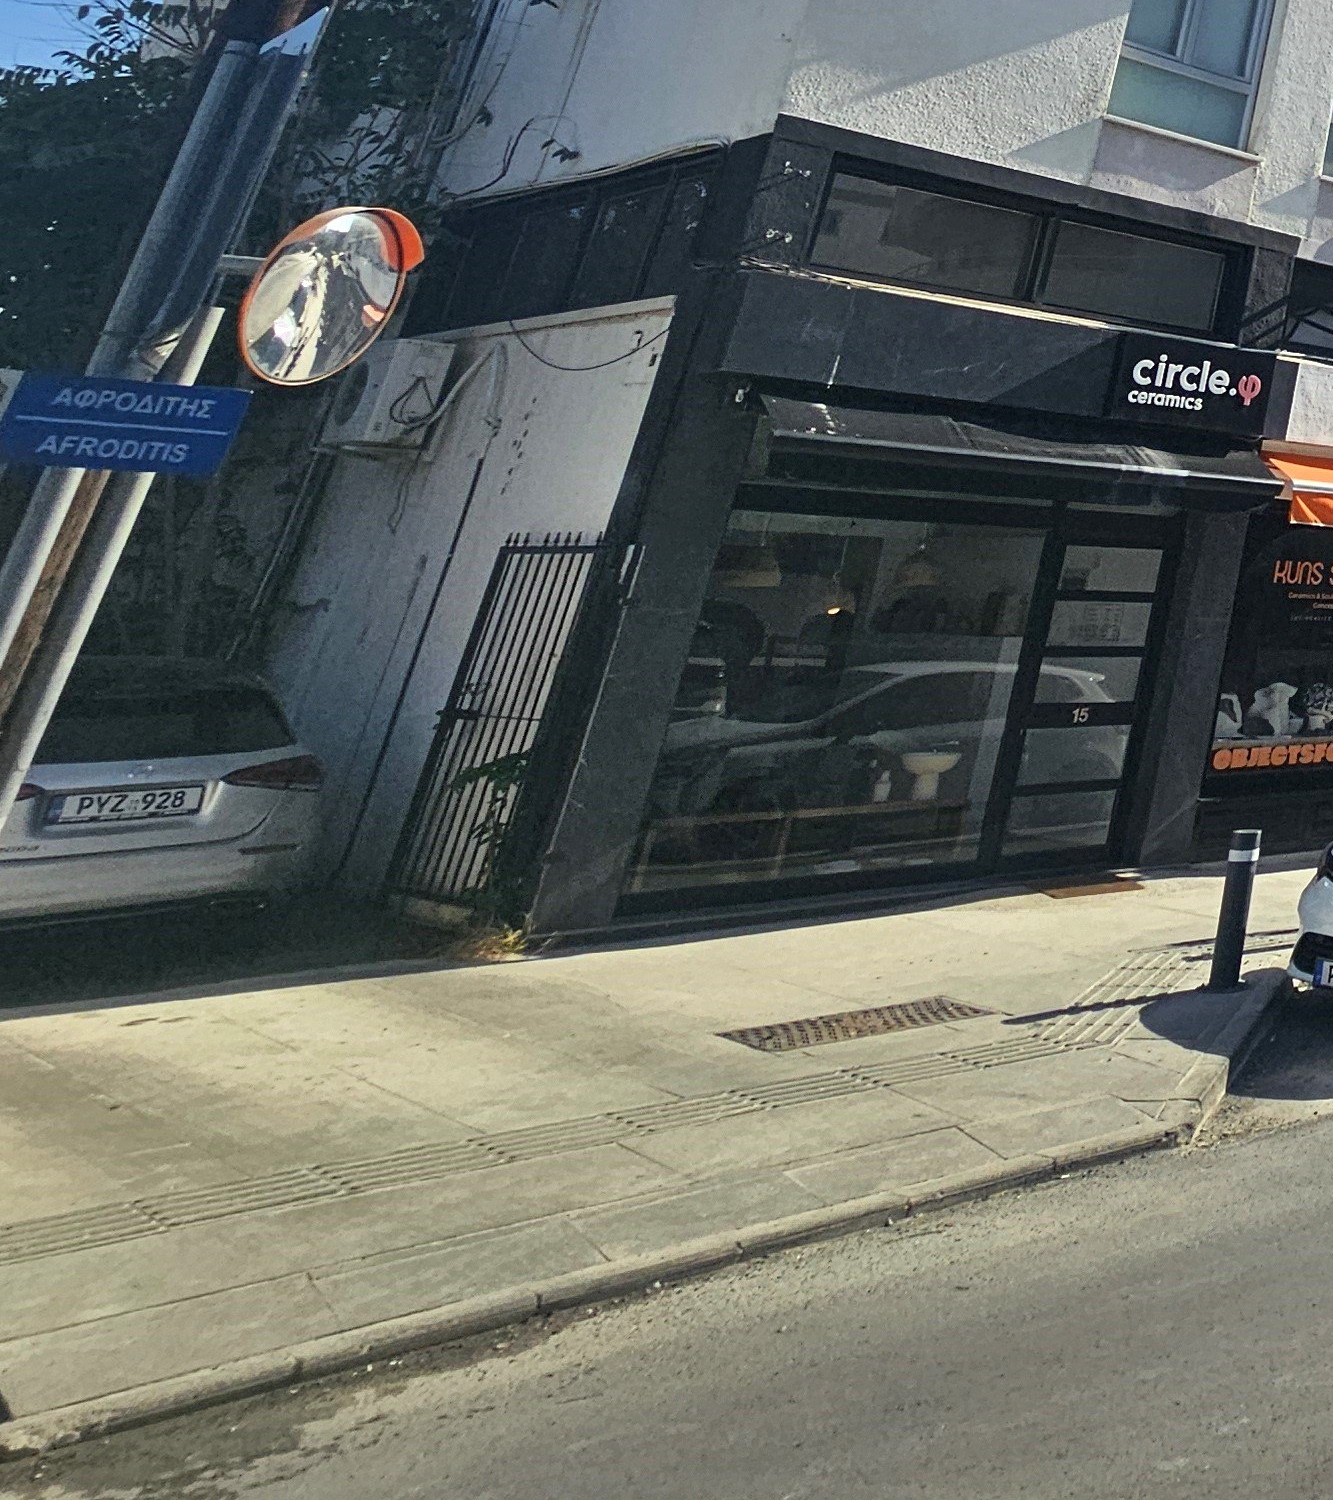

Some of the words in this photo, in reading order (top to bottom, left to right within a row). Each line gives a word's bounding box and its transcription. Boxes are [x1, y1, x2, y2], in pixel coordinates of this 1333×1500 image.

[51, 386, 218, 420] ΑΦΡΟΔΙΤΗΣ
[1127, 390, 1203, 411] ceramics
[35, 434, 191, 464] AFRODITIS
[1273, 560, 1324, 586] KUNS
[1072, 706, 1090, 724] 15
[77, 794, 129, 815] PYZ
[141, 790, 187, 811] 928
